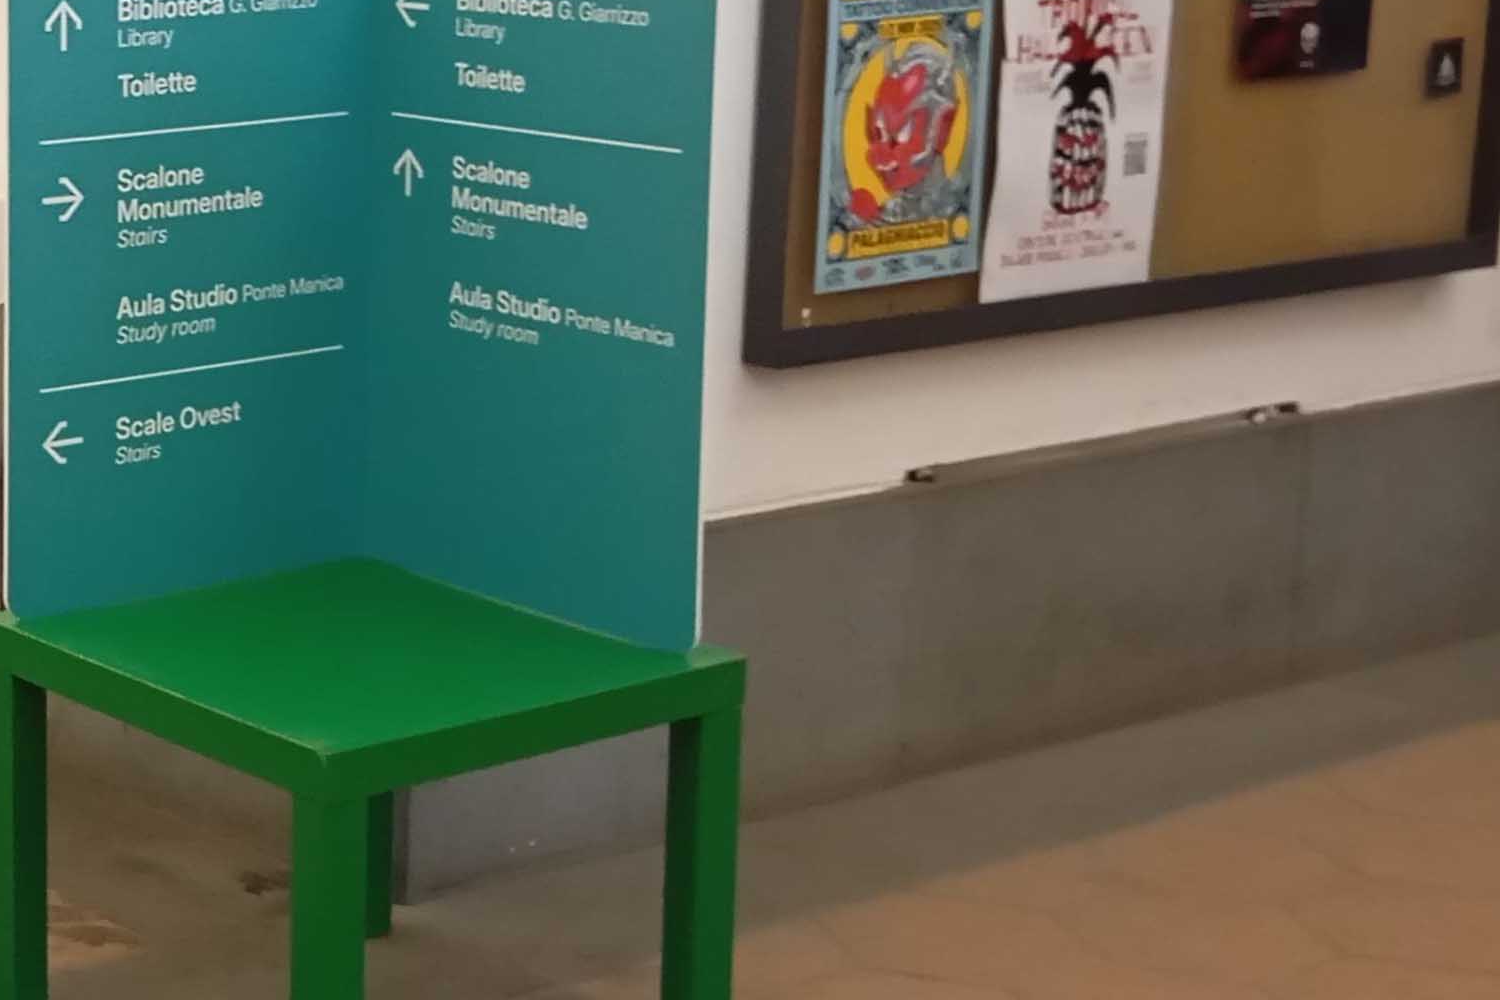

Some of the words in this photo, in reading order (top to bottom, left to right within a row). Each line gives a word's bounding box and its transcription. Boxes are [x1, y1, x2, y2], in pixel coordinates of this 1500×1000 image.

[557, 0, 576, 21] G.
[116, 27, 174, 49] Library
[454, 17, 506, 45] Library
[117, 71, 197, 98] Toilette
[454, 62, 526, 93] Toilette
[117, 165, 205, 193] Scalone
[452, 155, 531, 189] Scalone
[117, 186, 264, 223] Monumentale
[451, 185, 589, 230] Monumentale
[116, 226, 168, 249] Stairs
[450, 214, 497, 240] Stairs
[115, 292, 166, 320] Aula
[169, 283, 239, 313] Studio
[242, 283, 287, 303] Ponte
[289, 274, 344, 295] Manica
[449, 280, 492, 311] Aula
[496, 289, 561, 325] Studio
[565, 307, 611, 335] Ponte
[614, 316, 676, 348] Manica
[449, 310, 494, 340] Study
[496, 322, 541, 346] room
[116, 321, 167, 345] Study
[171, 316, 217, 338] room
[116, 410, 175, 440] Scale
[180, 400, 242, 430] Ovest
[115, 442, 162, 466] Stairs
